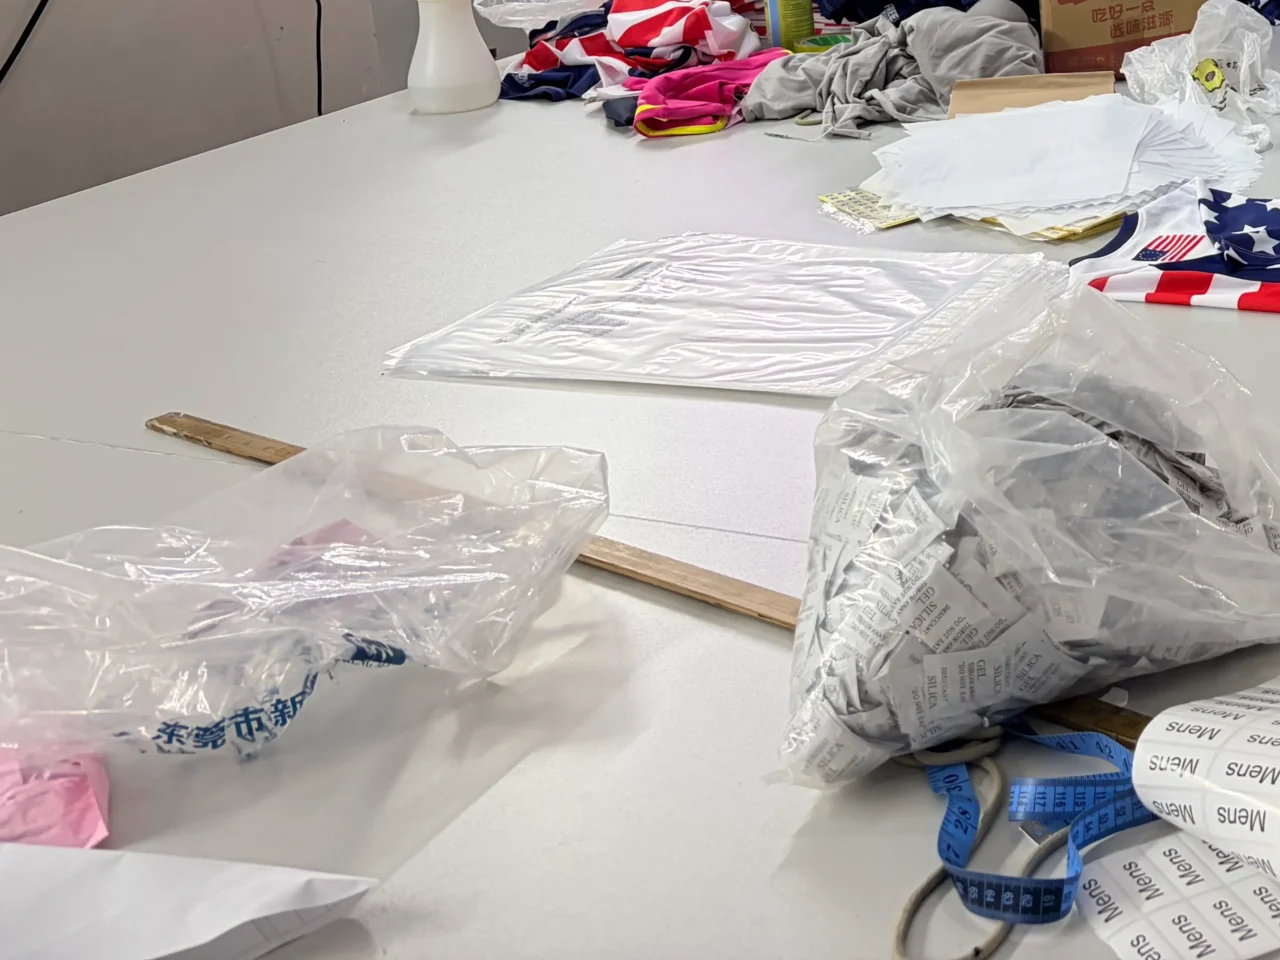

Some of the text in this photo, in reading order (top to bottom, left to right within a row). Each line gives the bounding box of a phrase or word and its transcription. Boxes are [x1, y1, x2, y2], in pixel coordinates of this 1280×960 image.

[1109, 10, 1174, 40] 选味滋源
[916, 586, 936, 607] GEL
[909, 601, 938, 631] SILICA
[959, 627, 979, 646] GEL
[976, 658, 987, 682] GEL
[1015, 652, 1043, 682] SILICA
[927, 675, 938, 709] SILICA
[1190, 706, 1247, 721] Mens
[1165, 721, 1222, 741] Mens
[1149, 754, 1200, 778] Mens
[1036, 791, 1047, 808] 117
[1055, 791, 1066, 808] 116
[1152, 800, 1196, 825] Mens
[1217, 806, 1267, 833] Mens
[1163, 847, 1205, 887] Mens
[1122, 860, 1164, 902] Mens
[1082, 878, 1123, 923] Mens
[1213, 899, 1258, 942] Mens
[1130, 933, 1167, 960] ens
[1171, 913, 1217, 959] Mens
